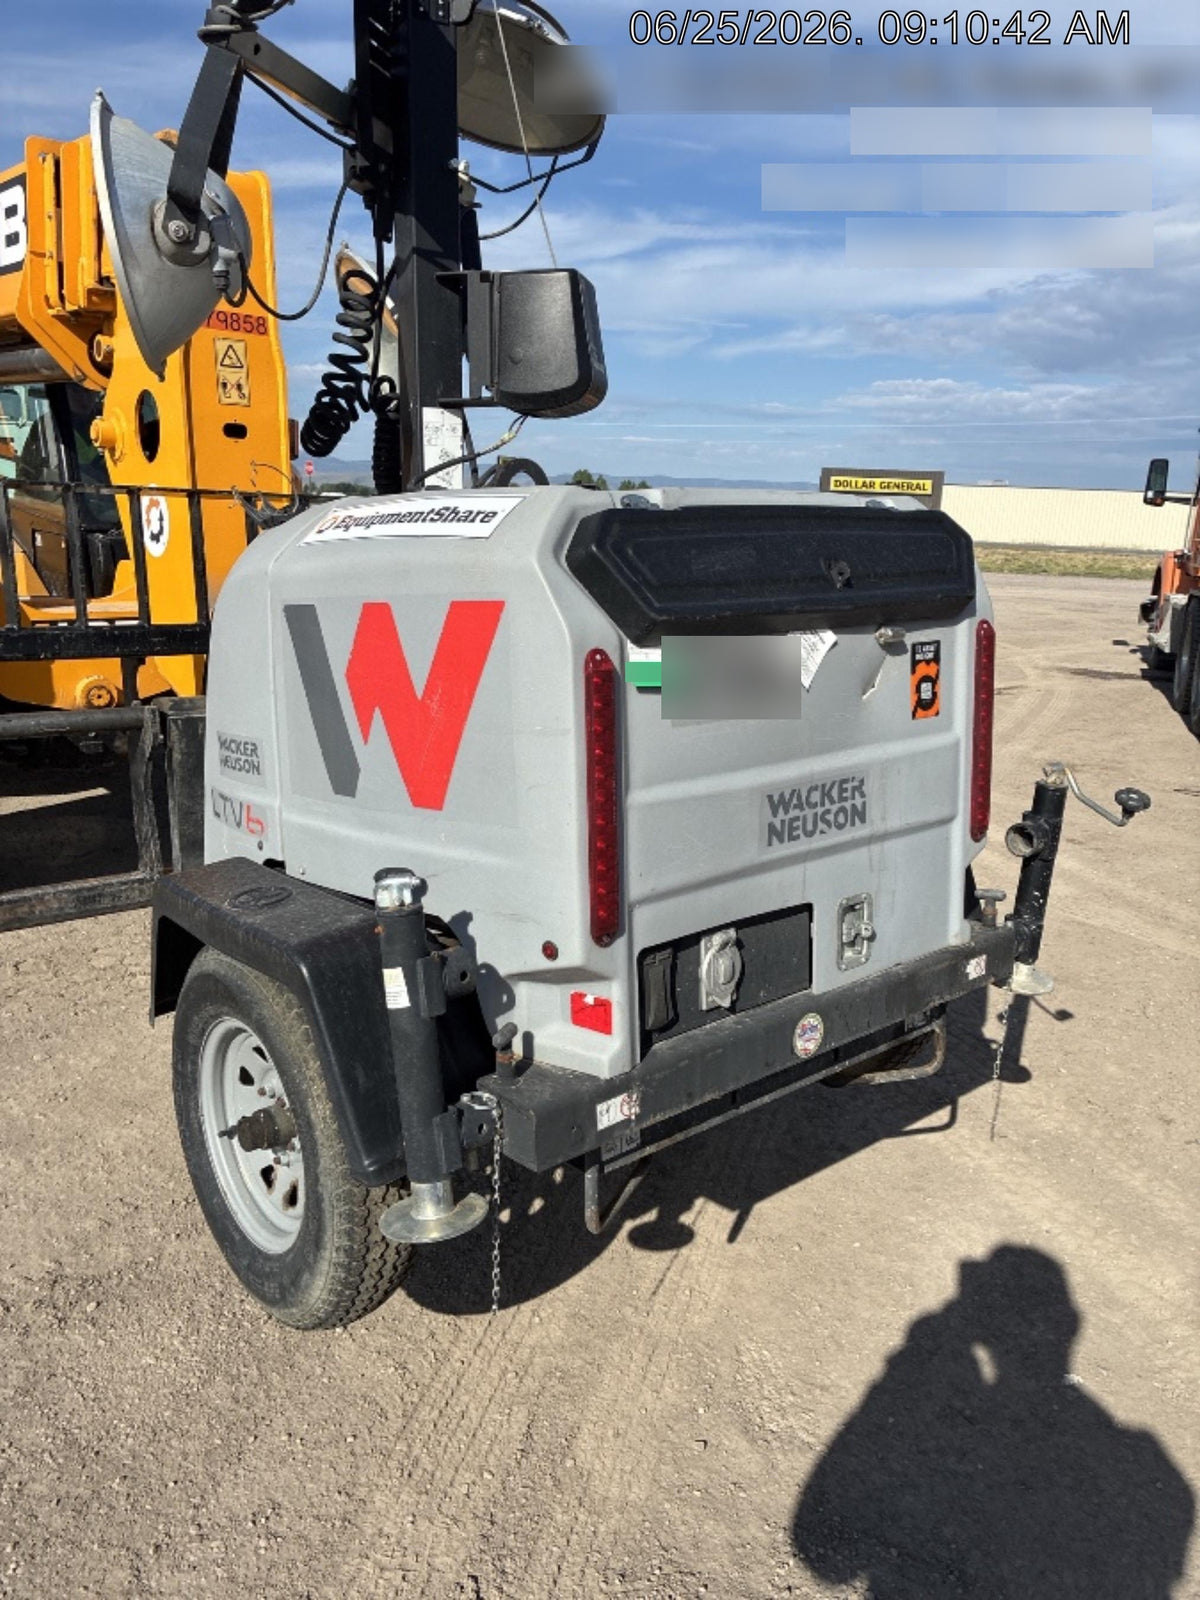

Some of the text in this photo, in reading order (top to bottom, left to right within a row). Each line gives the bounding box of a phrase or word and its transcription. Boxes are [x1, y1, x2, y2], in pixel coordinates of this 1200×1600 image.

[833, 479, 929, 492] DOLLAR GENERAL
[333, 506, 498, 532] EquipmentShare
[766, 776, 866, 818] WACKER
[766, 800, 867, 847] NEUSON
